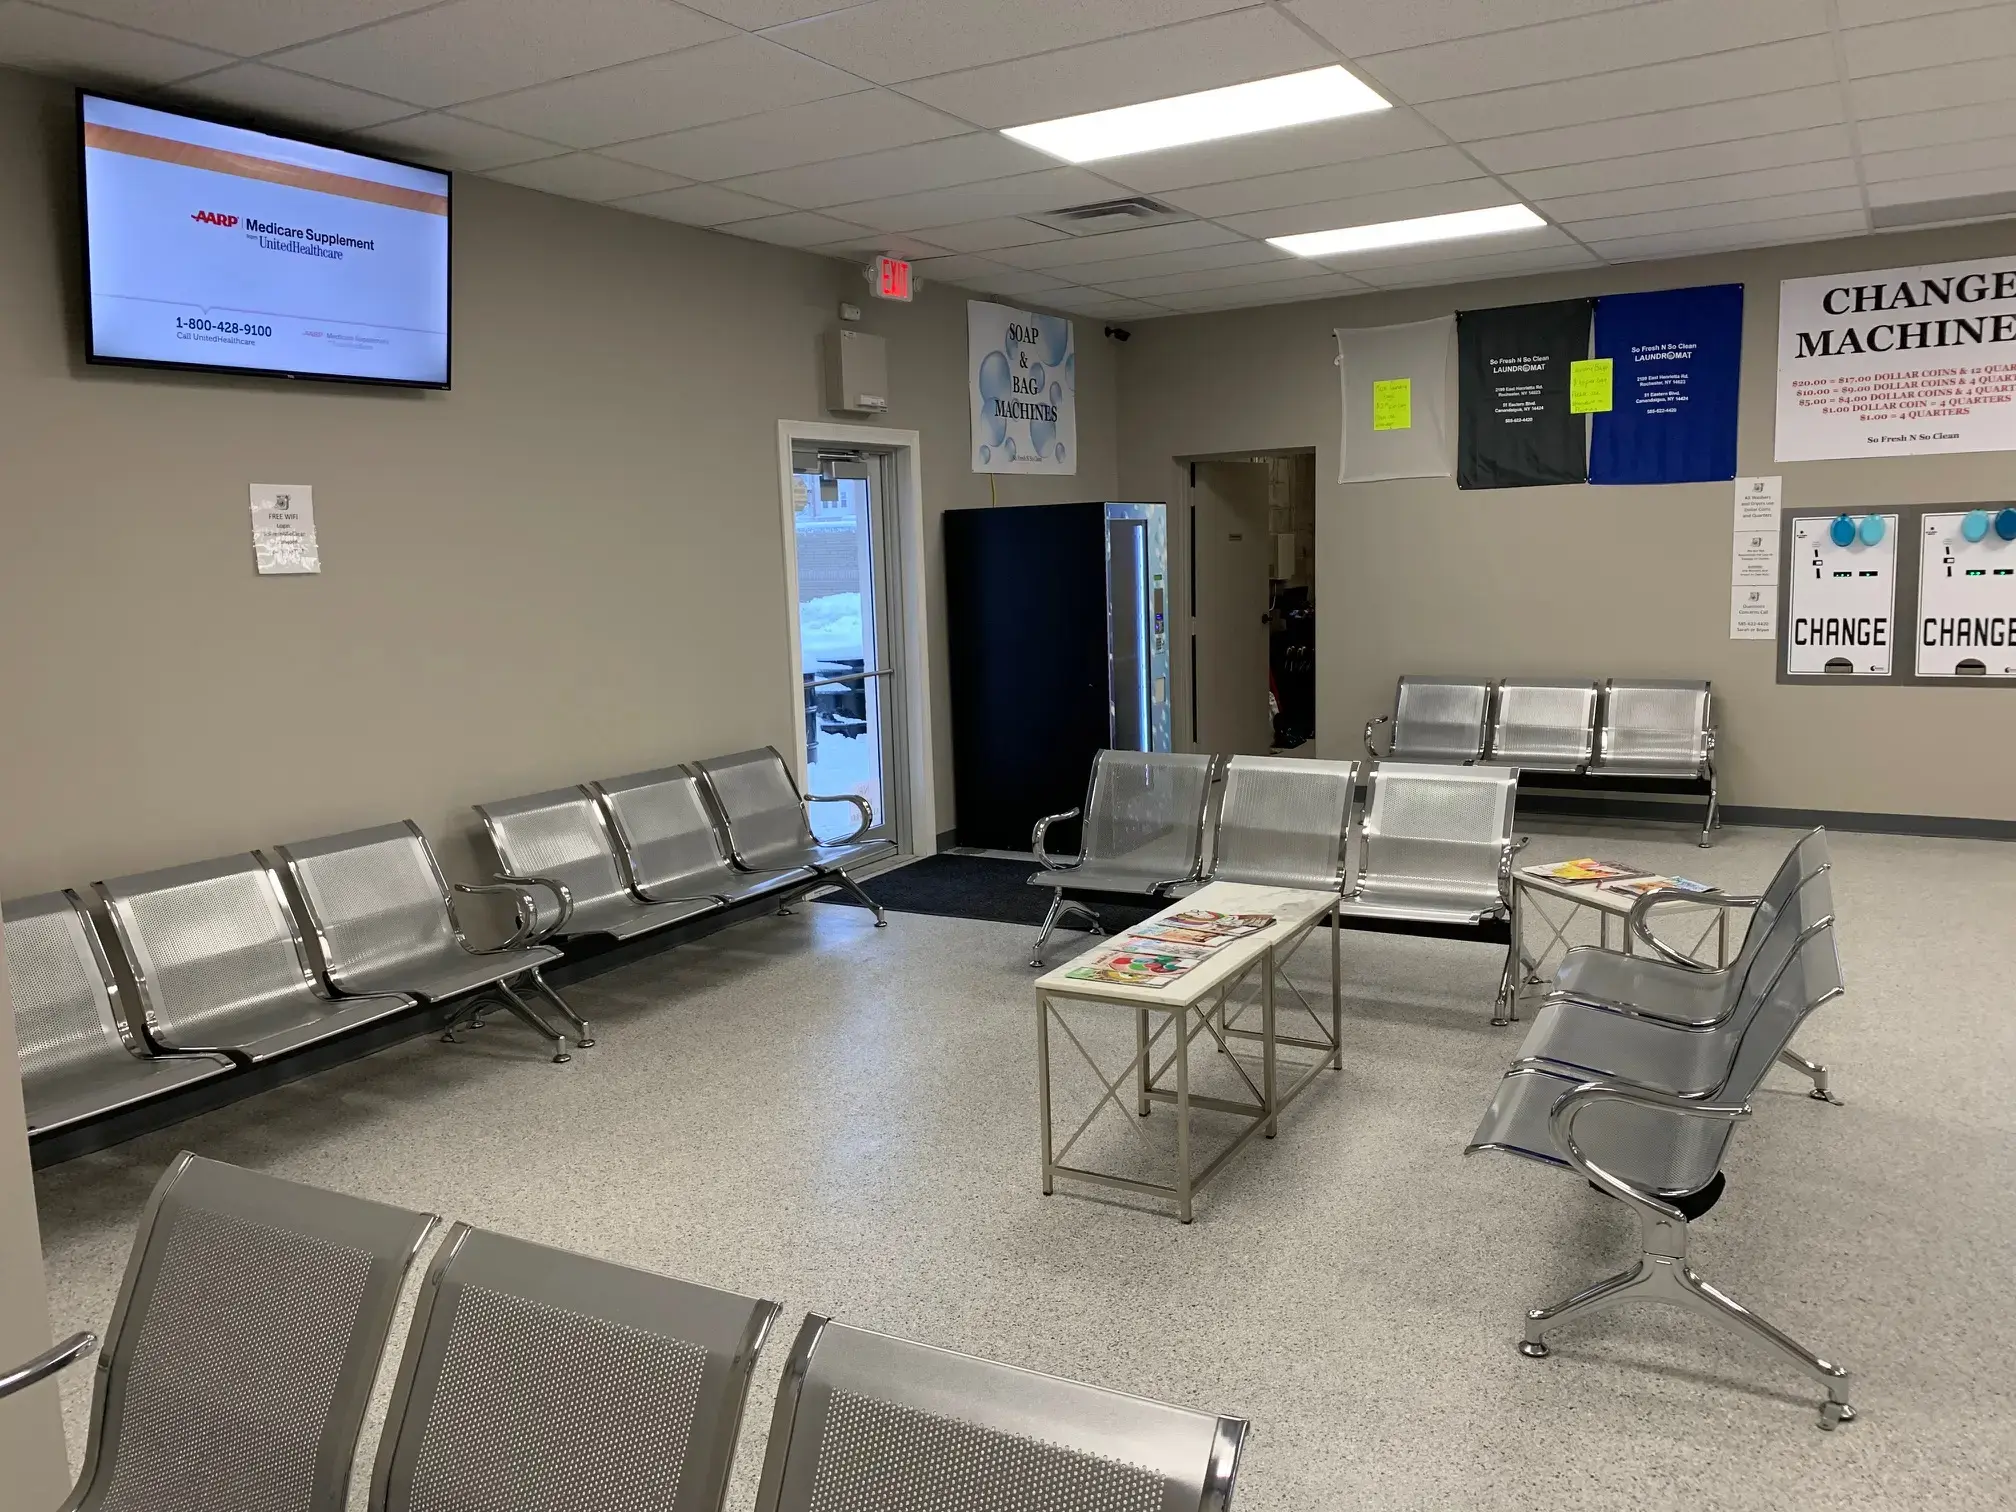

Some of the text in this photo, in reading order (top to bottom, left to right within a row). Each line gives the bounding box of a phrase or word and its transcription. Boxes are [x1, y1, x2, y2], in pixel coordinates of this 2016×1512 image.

[191, 210, 375, 251] AARP Medicare Supplement
[259, 236, 344, 260] UnitedHealthcare
[882, 258, 908, 298] EXIT
[1822, 271, 2016, 315] CHANGE
[176, 316, 272, 338] 1-800-428-9100
[1009, 323, 1039, 344] SOAP
[177, 332, 256, 346] Call UnitedHealthcare
[1019, 351, 1028, 369] &
[1635, 351, 1692, 362] LAUNDROMAT
[1493, 363, 1546, 373] LAUNDROMAT
[1792, 379, 1827, 388] $20.00
[1838, 375, 1871, 384] $17.00
[1874, 370, 1919, 381] DOLLAR
[1921, 367, 1957, 377] COINS
[1959, 366, 1968, 375] &
[1013, 376, 1038, 395] BAG
[1796, 388, 1830, 397] $10.00
[1841, 385, 1871, 395] $9.00
[1873, 380, 1918, 391] DOLLAR
[1920, 377, 1956, 388] COINS
[1958, 376, 1966, 384] &
[1969, 377, 1976, 386] 4
[1799, 397, 1827, 407] $5.00
[1838, 395, 1867, 404] $4.00
[1870, 390, 1915, 401] DOLLAR
[1917, 387, 1953, 398] COINS
[1955, 387, 1963, 395] &
[1965, 387, 1972, 396] 4
[1822, 405, 1850, 415] $1.00
[1852, 401, 1897, 412] DOLLAR
[1899, 399, 1927, 409] COIN
[1940, 398, 1946, 407] 4
[1949, 394, 2012, 406] QUARTERS
[994, 399, 1058, 422] MACHINES
[1860, 412, 1888, 421] $1.00
[1899, 412, 1906, 421] 4
[1908, 407, 1970, 419] QUARTERS
[1867, 431, 1960, 444] So Fresh N So Clean
[1795, 617, 1887, 646] CHANGE
[1923, 618, 2016, 647] CHANGE
